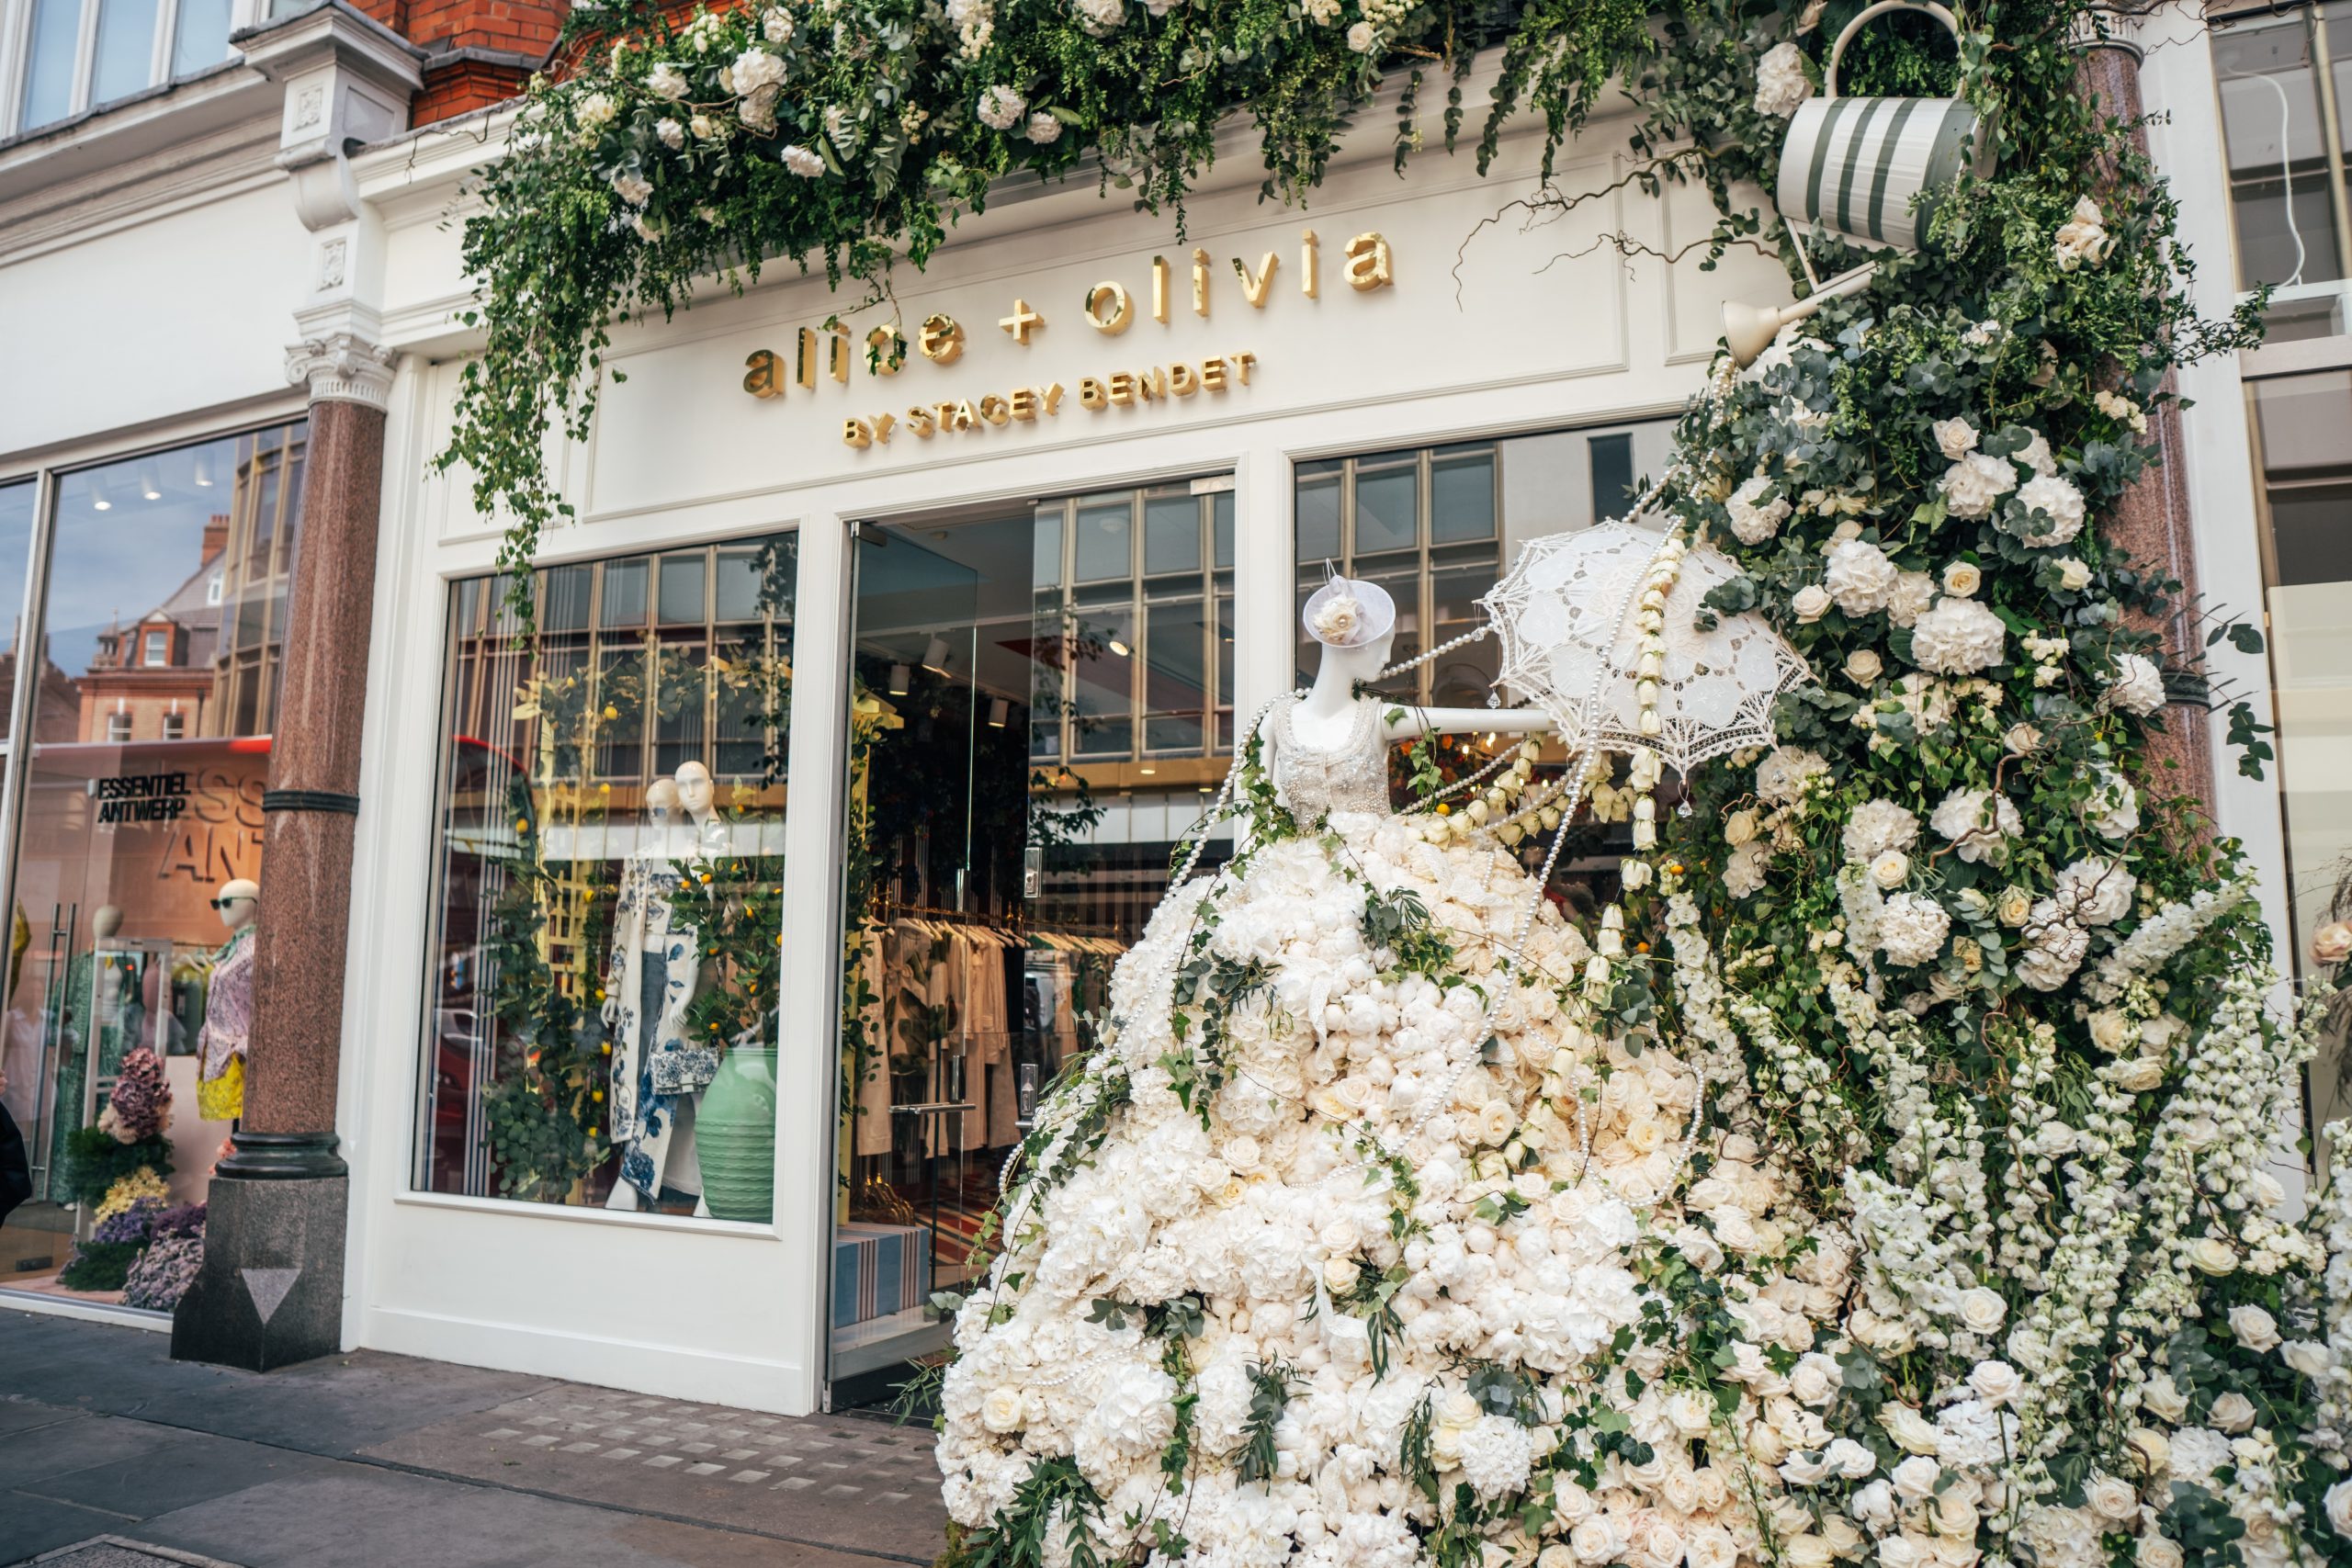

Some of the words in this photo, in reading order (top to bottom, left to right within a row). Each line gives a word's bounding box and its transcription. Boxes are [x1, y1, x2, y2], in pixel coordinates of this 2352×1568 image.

[743, 313, 966, 399] alice
[998, 299, 1045, 345] +
[1084, 228, 1394, 337] olivia
[842, 412, 897, 448] BY
[906, 381, 1065, 438] STACEY
[1079, 350, 1257, 412] BENDET
[97, 773, 191, 800] ESSENTIEL
[97, 798, 187, 824] ANTWERP
